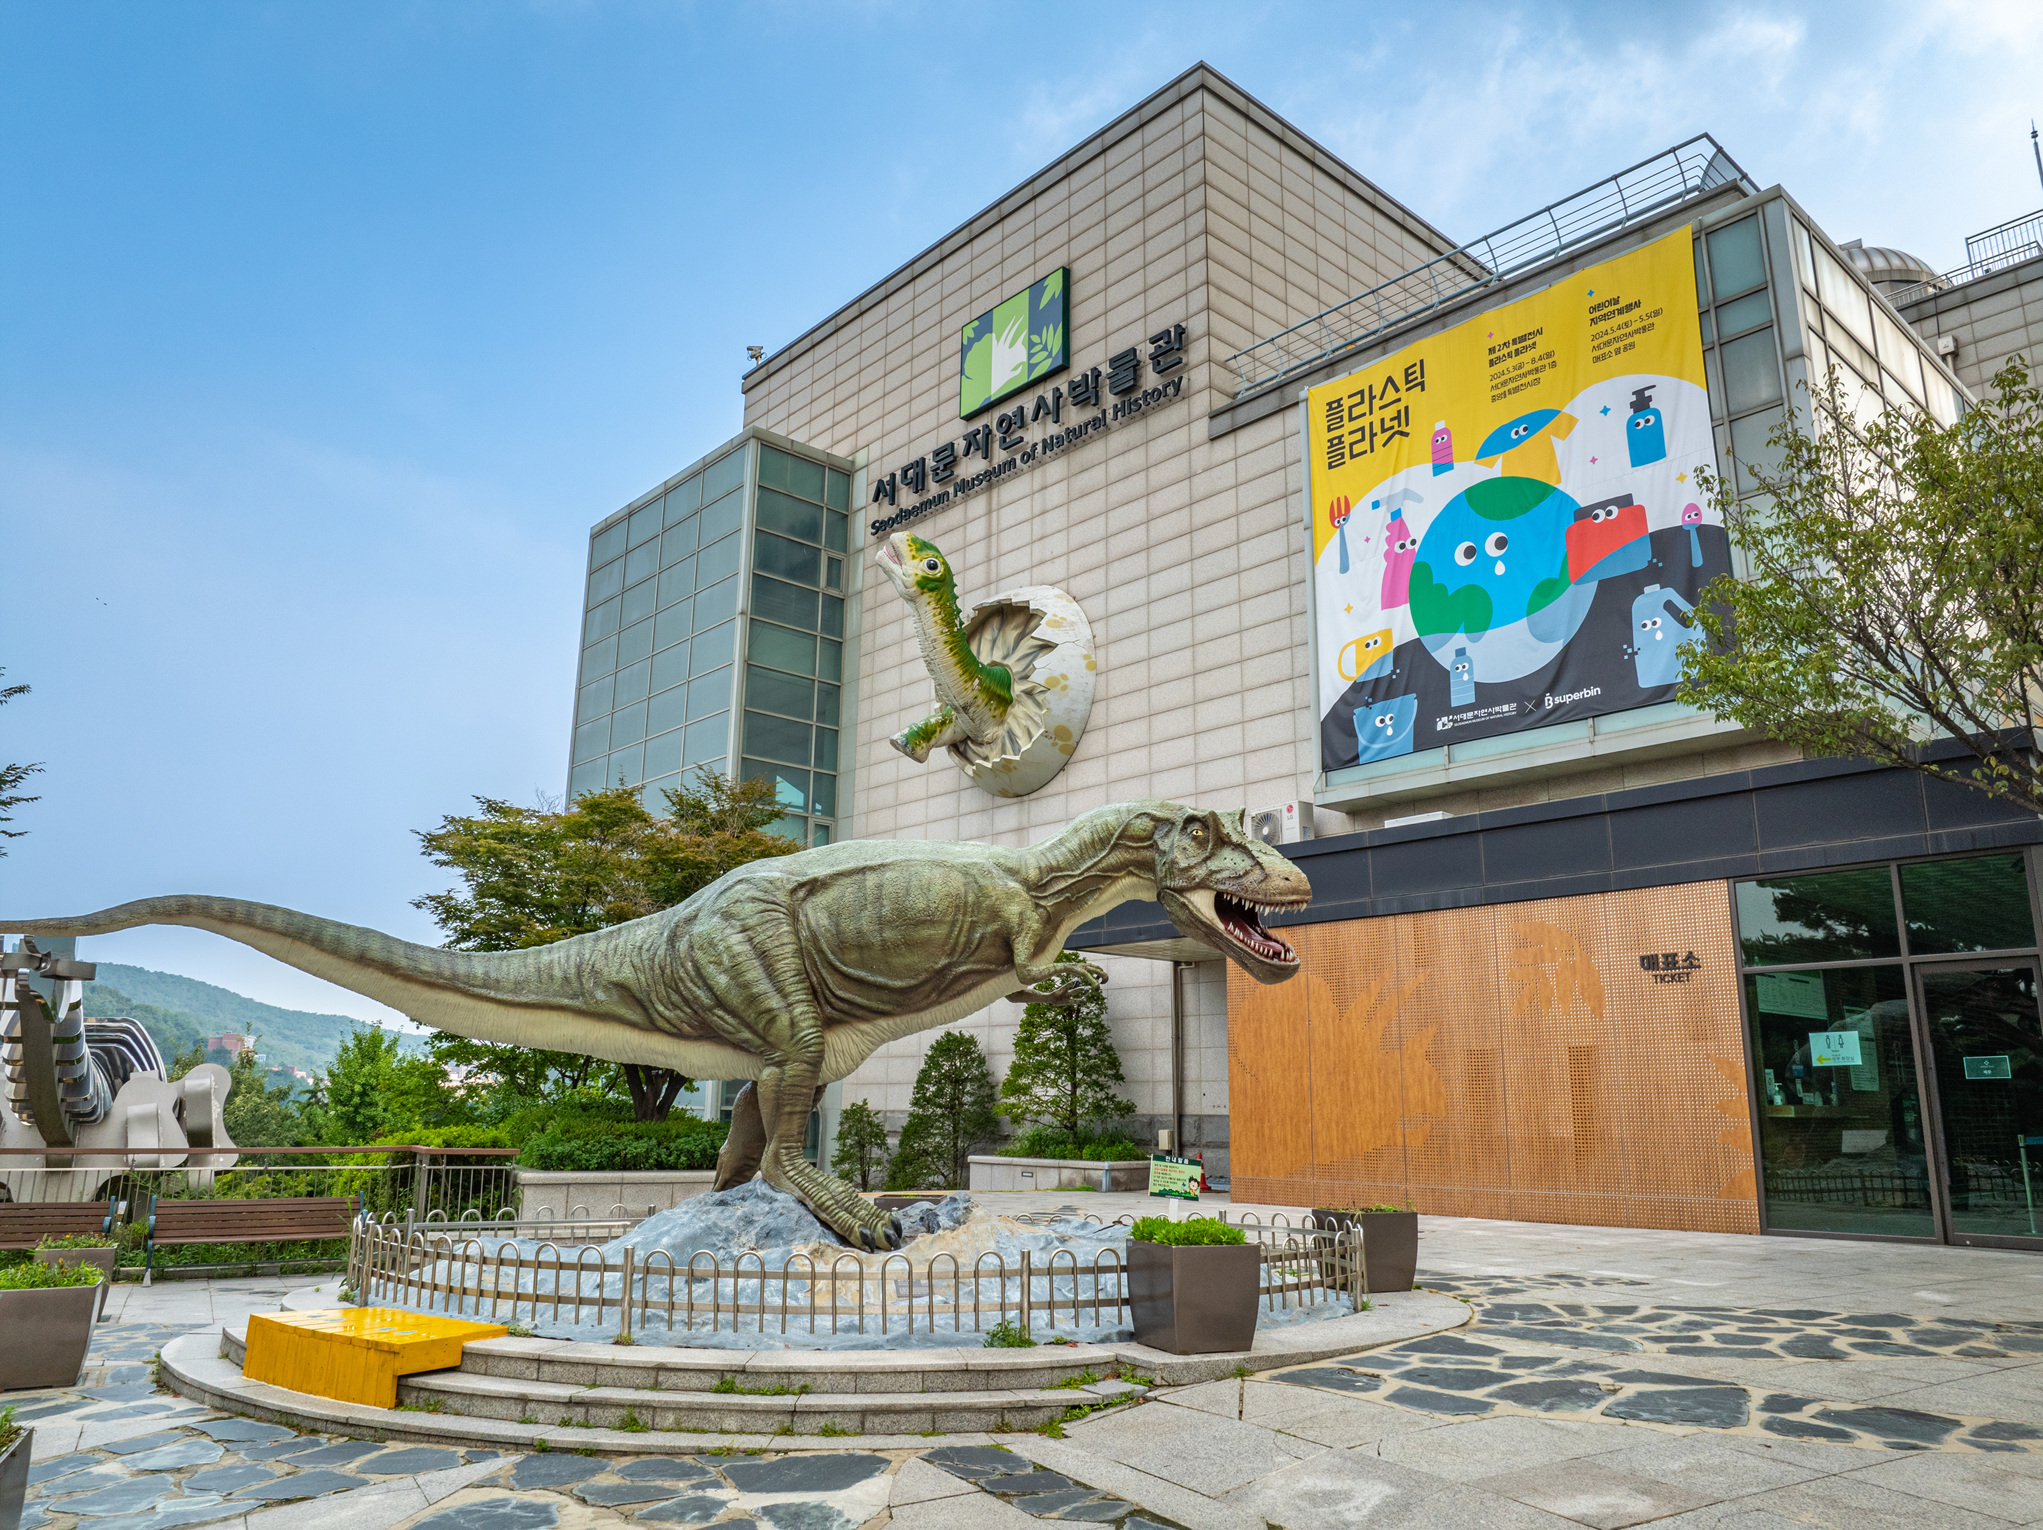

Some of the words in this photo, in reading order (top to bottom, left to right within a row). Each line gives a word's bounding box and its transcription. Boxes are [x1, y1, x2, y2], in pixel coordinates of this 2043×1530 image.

[1589, 296, 1620, 315] 어린이날
[1589, 299, 1642, 327] 지역연계행사
[1590, 319, 1633, 342] 2024.5.4(토)
[1591, 322, 1655, 353] 서대문자연사박물관
[1488, 350, 1514, 368] 플라스틱
[1514, 341, 1537, 358] 플라넷
[1592, 350, 1613, 364] 매표소
[1489, 361, 1525, 382] 2024.5.3(금)
[1490, 364, 1547, 392] 서대문자연사박물관
[1325, 358, 1426, 433] 플라스틱
[872, 323, 1185, 506] 서대문자연사박물관
[1326, 404, 1410, 471] 플라넷
[870, 491, 951, 536] Seodaemun
[952, 456, 1017, 499] Museum
[1019, 446, 1039, 466] of
[1041, 410, 1107, 453] Natural
[1110, 375, 1185, 422] History
[1554, 686, 1601, 705] superbin
[1453, 703, 1517, 721] 서대문자연사박물관
[1639, 951, 1701, 971] 매표소
[1652, 972, 1690, 985] TICKET
